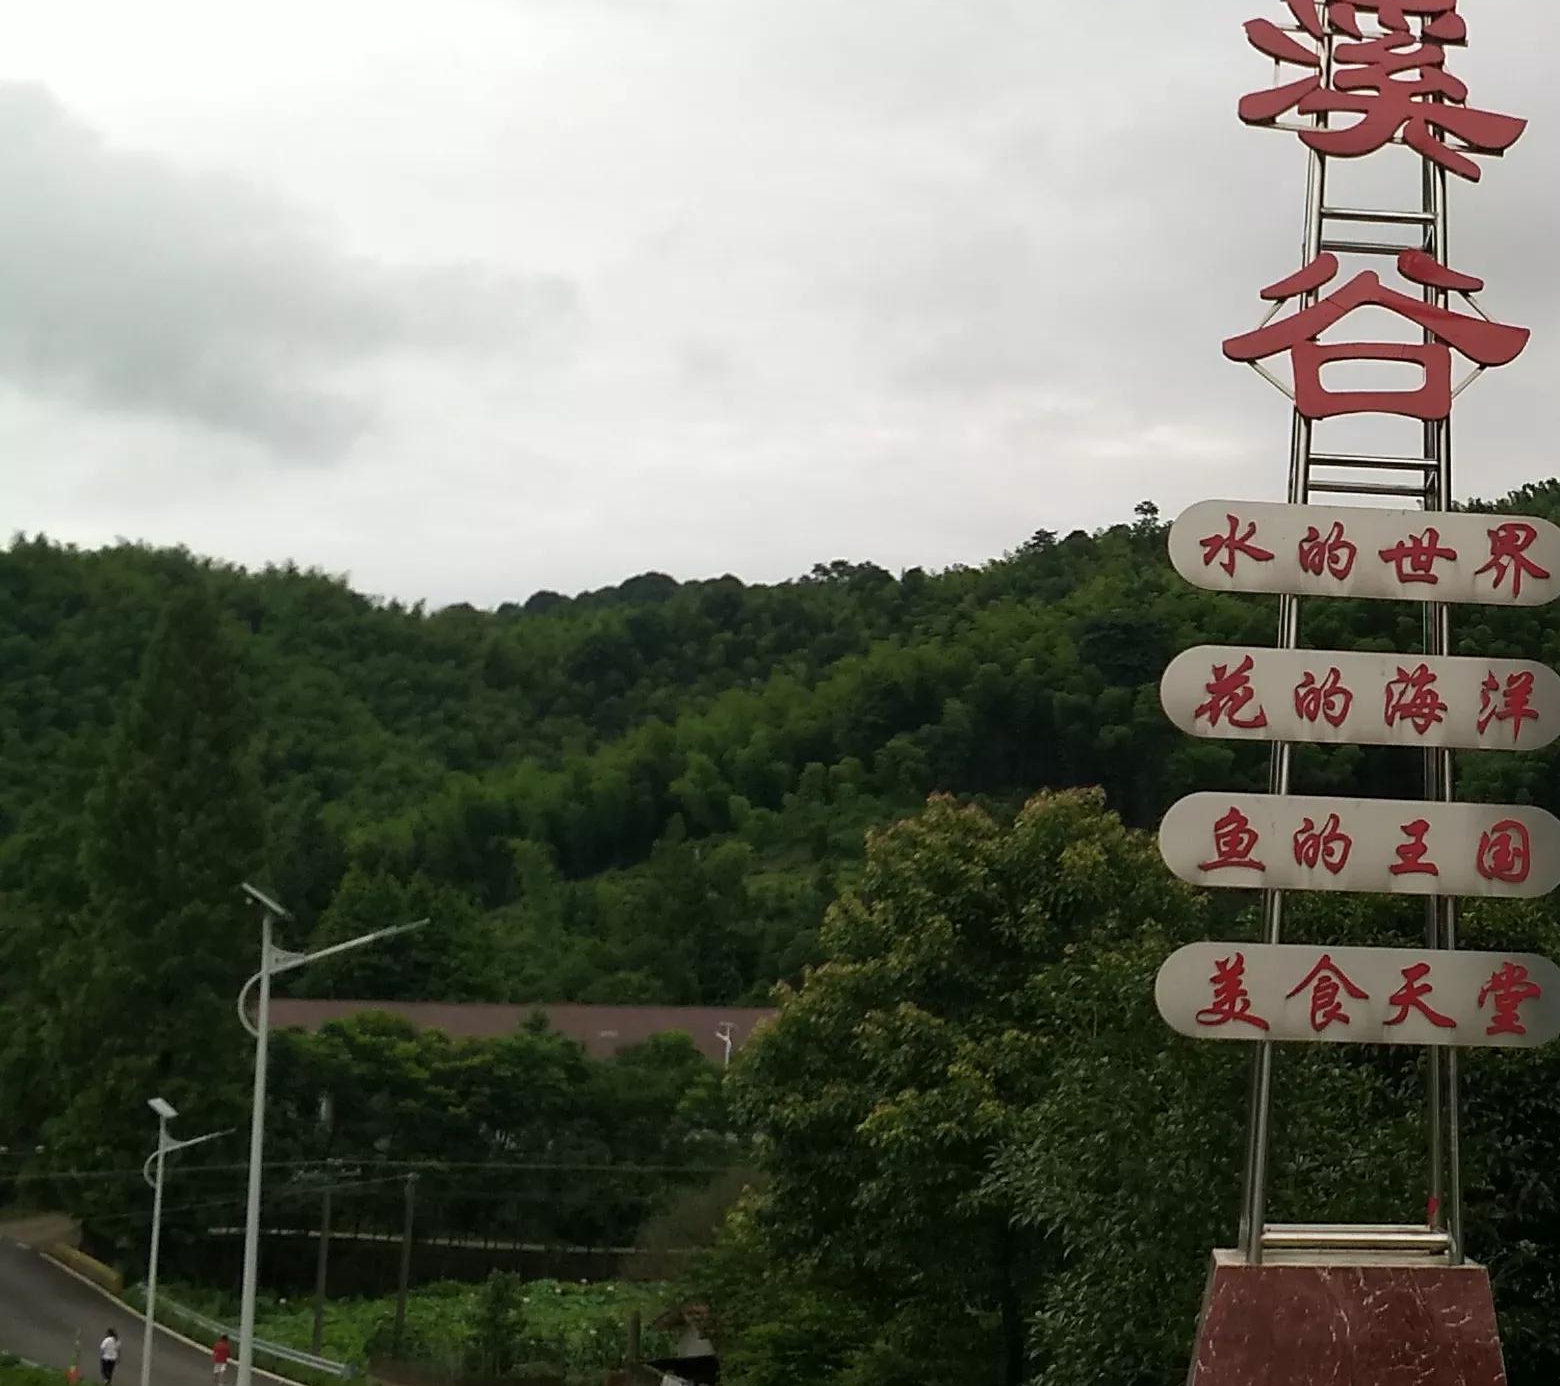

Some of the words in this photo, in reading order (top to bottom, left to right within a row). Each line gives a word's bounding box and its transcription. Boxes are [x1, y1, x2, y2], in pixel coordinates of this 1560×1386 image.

[1200, 514, 1550, 599] 水的世界
[1194, 654, 1540, 742] 花的海洋
[1197, 806, 1531, 884] 鱼的王国
[1195, 952, 1543, 1036] 美食天堂
